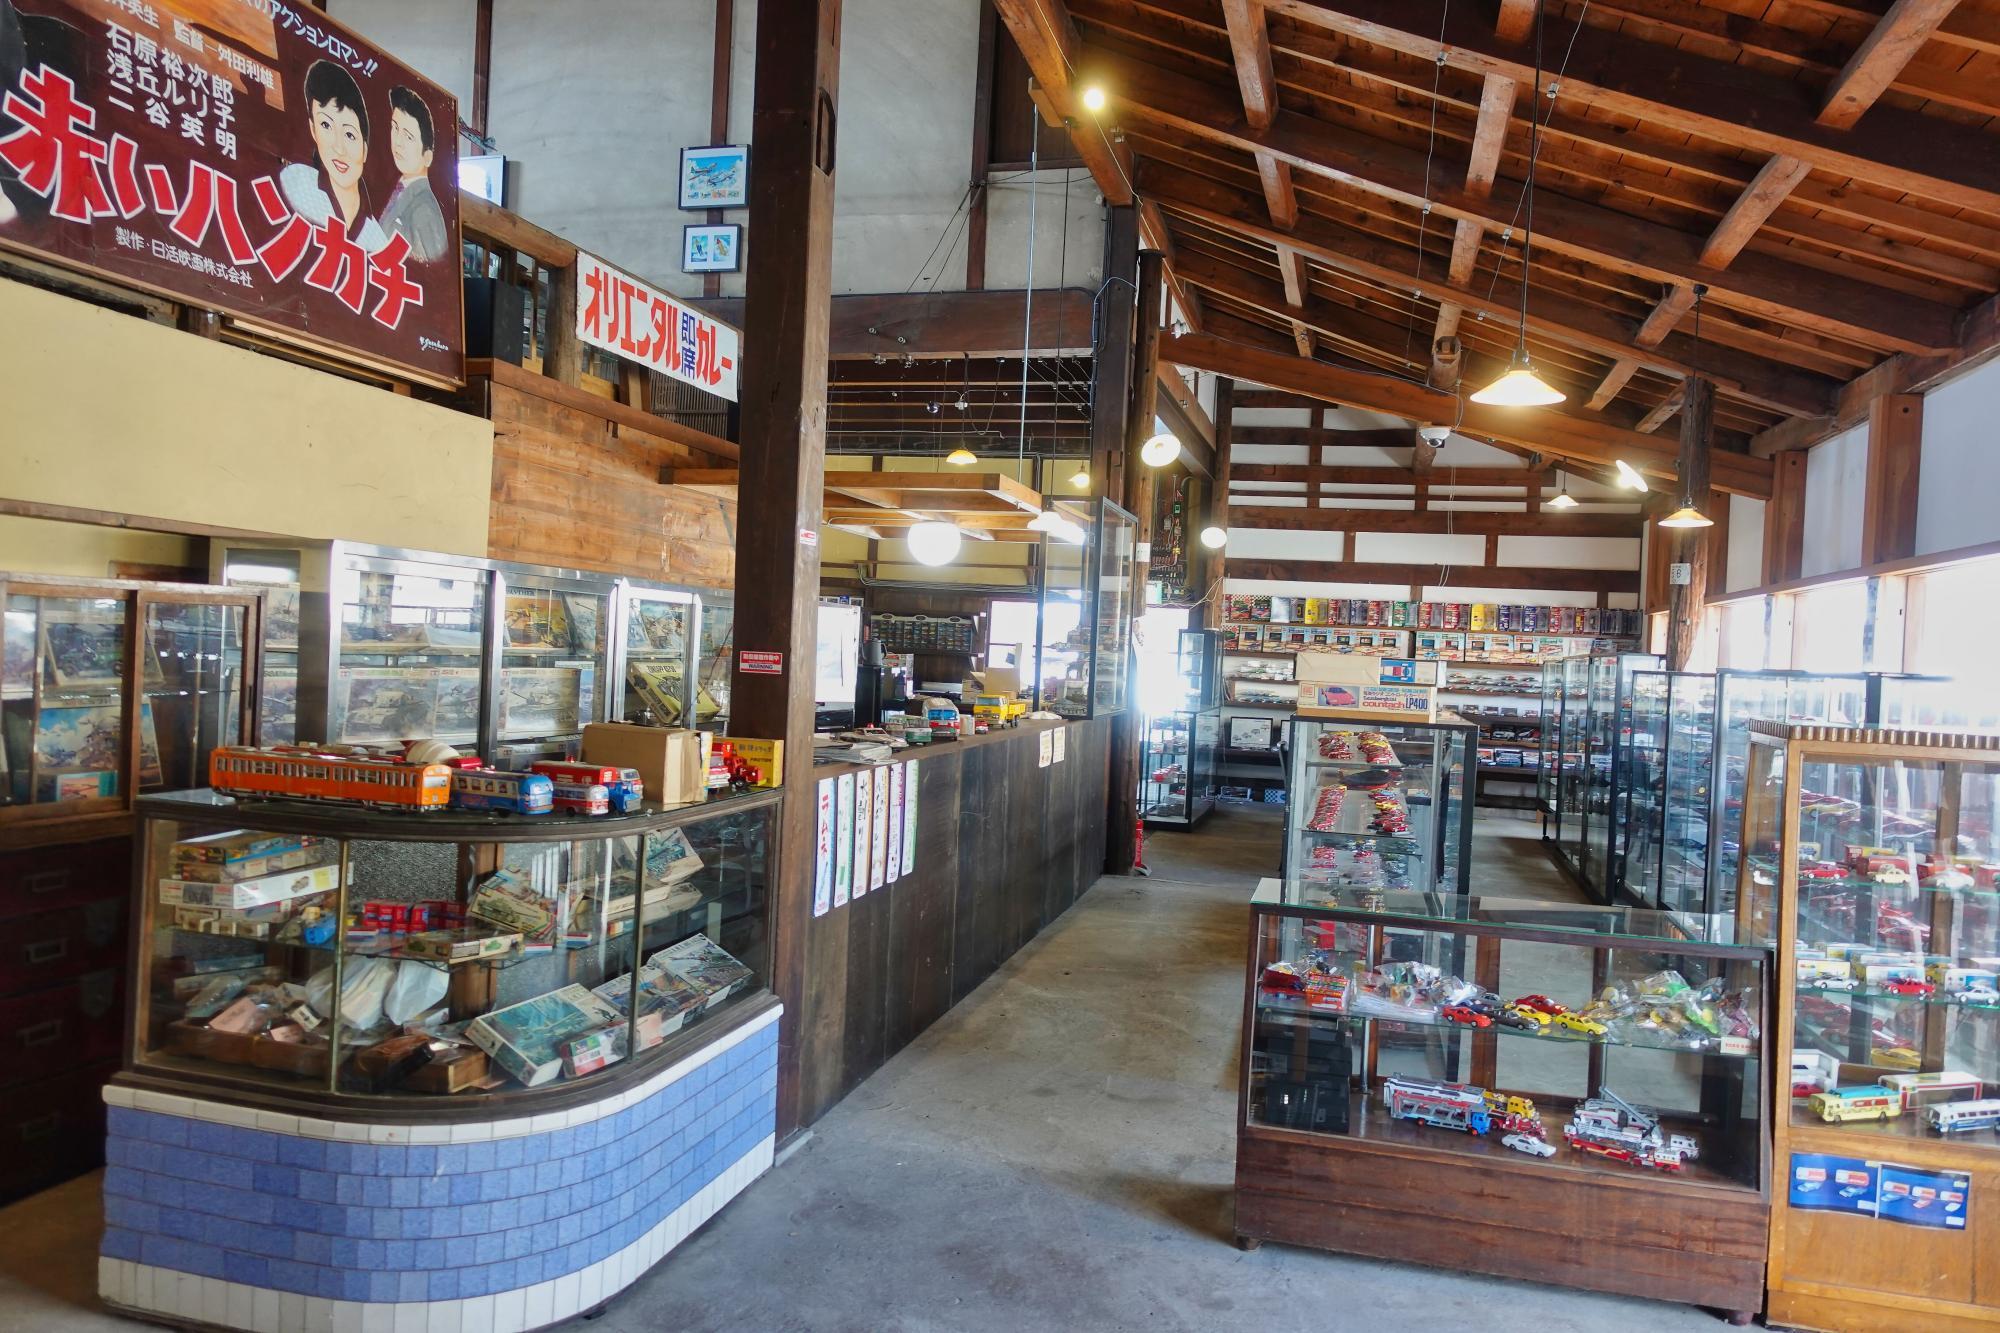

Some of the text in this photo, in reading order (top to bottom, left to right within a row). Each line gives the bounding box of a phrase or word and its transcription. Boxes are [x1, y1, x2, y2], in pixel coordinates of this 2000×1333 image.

[106, 19, 235, 105] 石原裕次郎
[107, 48, 236, 130] 浅丘ルリ子
[108, 79, 238, 161] 二谷英明
[0, 63, 424, 330] 赤いハンカチ
[1406, 697, 1429, 710] LP400
